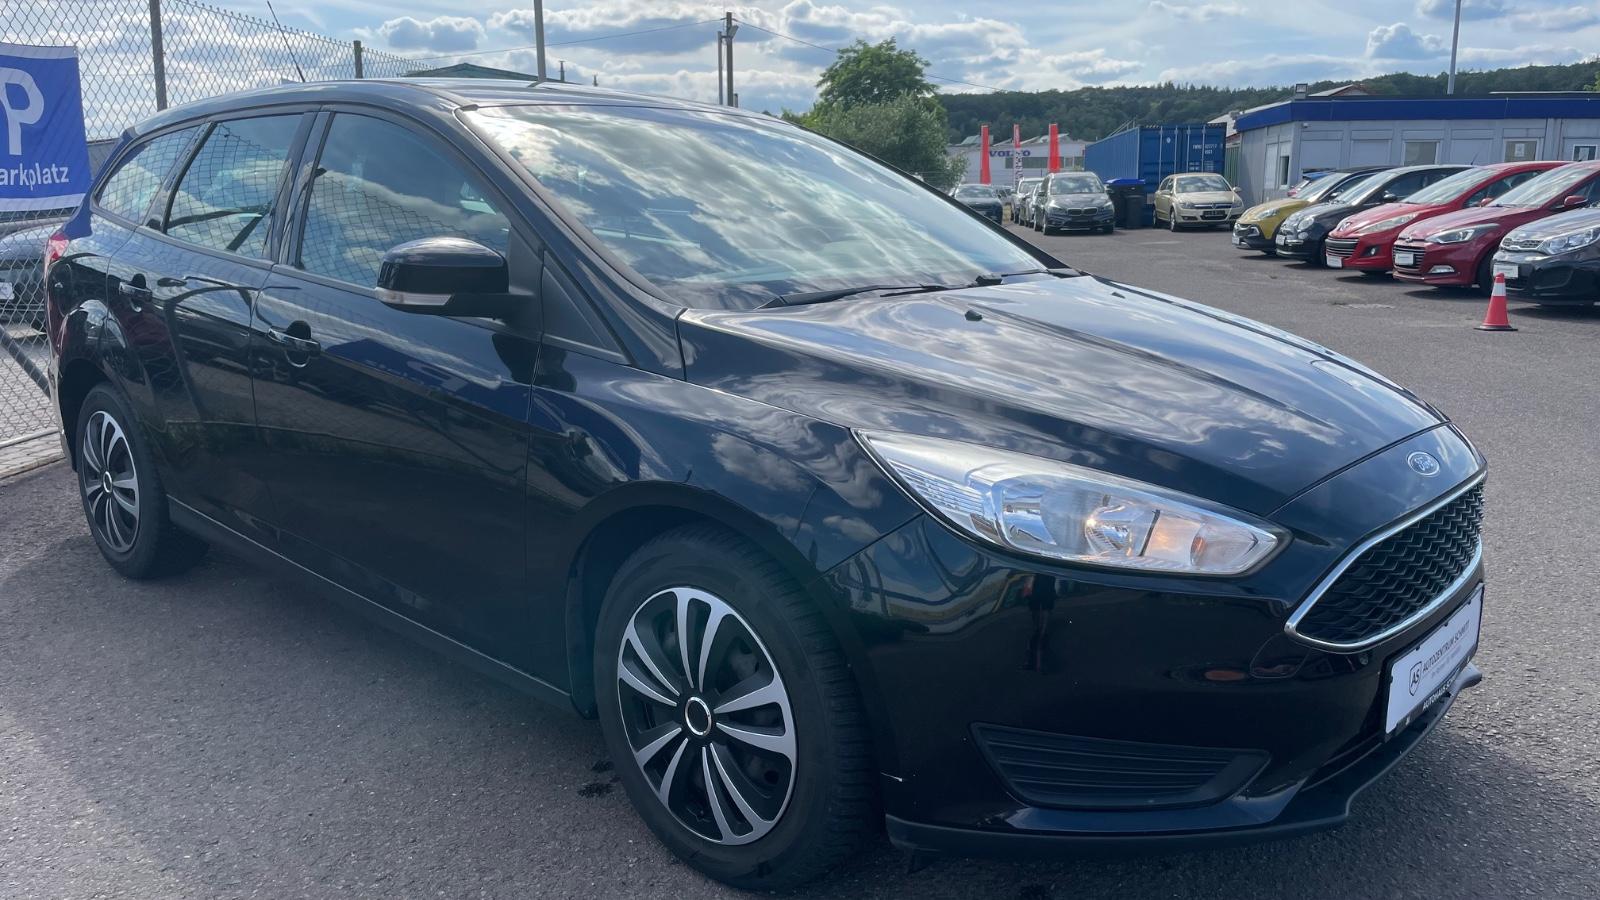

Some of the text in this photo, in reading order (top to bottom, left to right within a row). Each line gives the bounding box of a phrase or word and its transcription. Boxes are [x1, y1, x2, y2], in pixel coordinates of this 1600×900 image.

[0, 67, 44, 155] P
[989, 150, 1030, 158] VOLO
[0, 163, 69, 191] arkplatz
